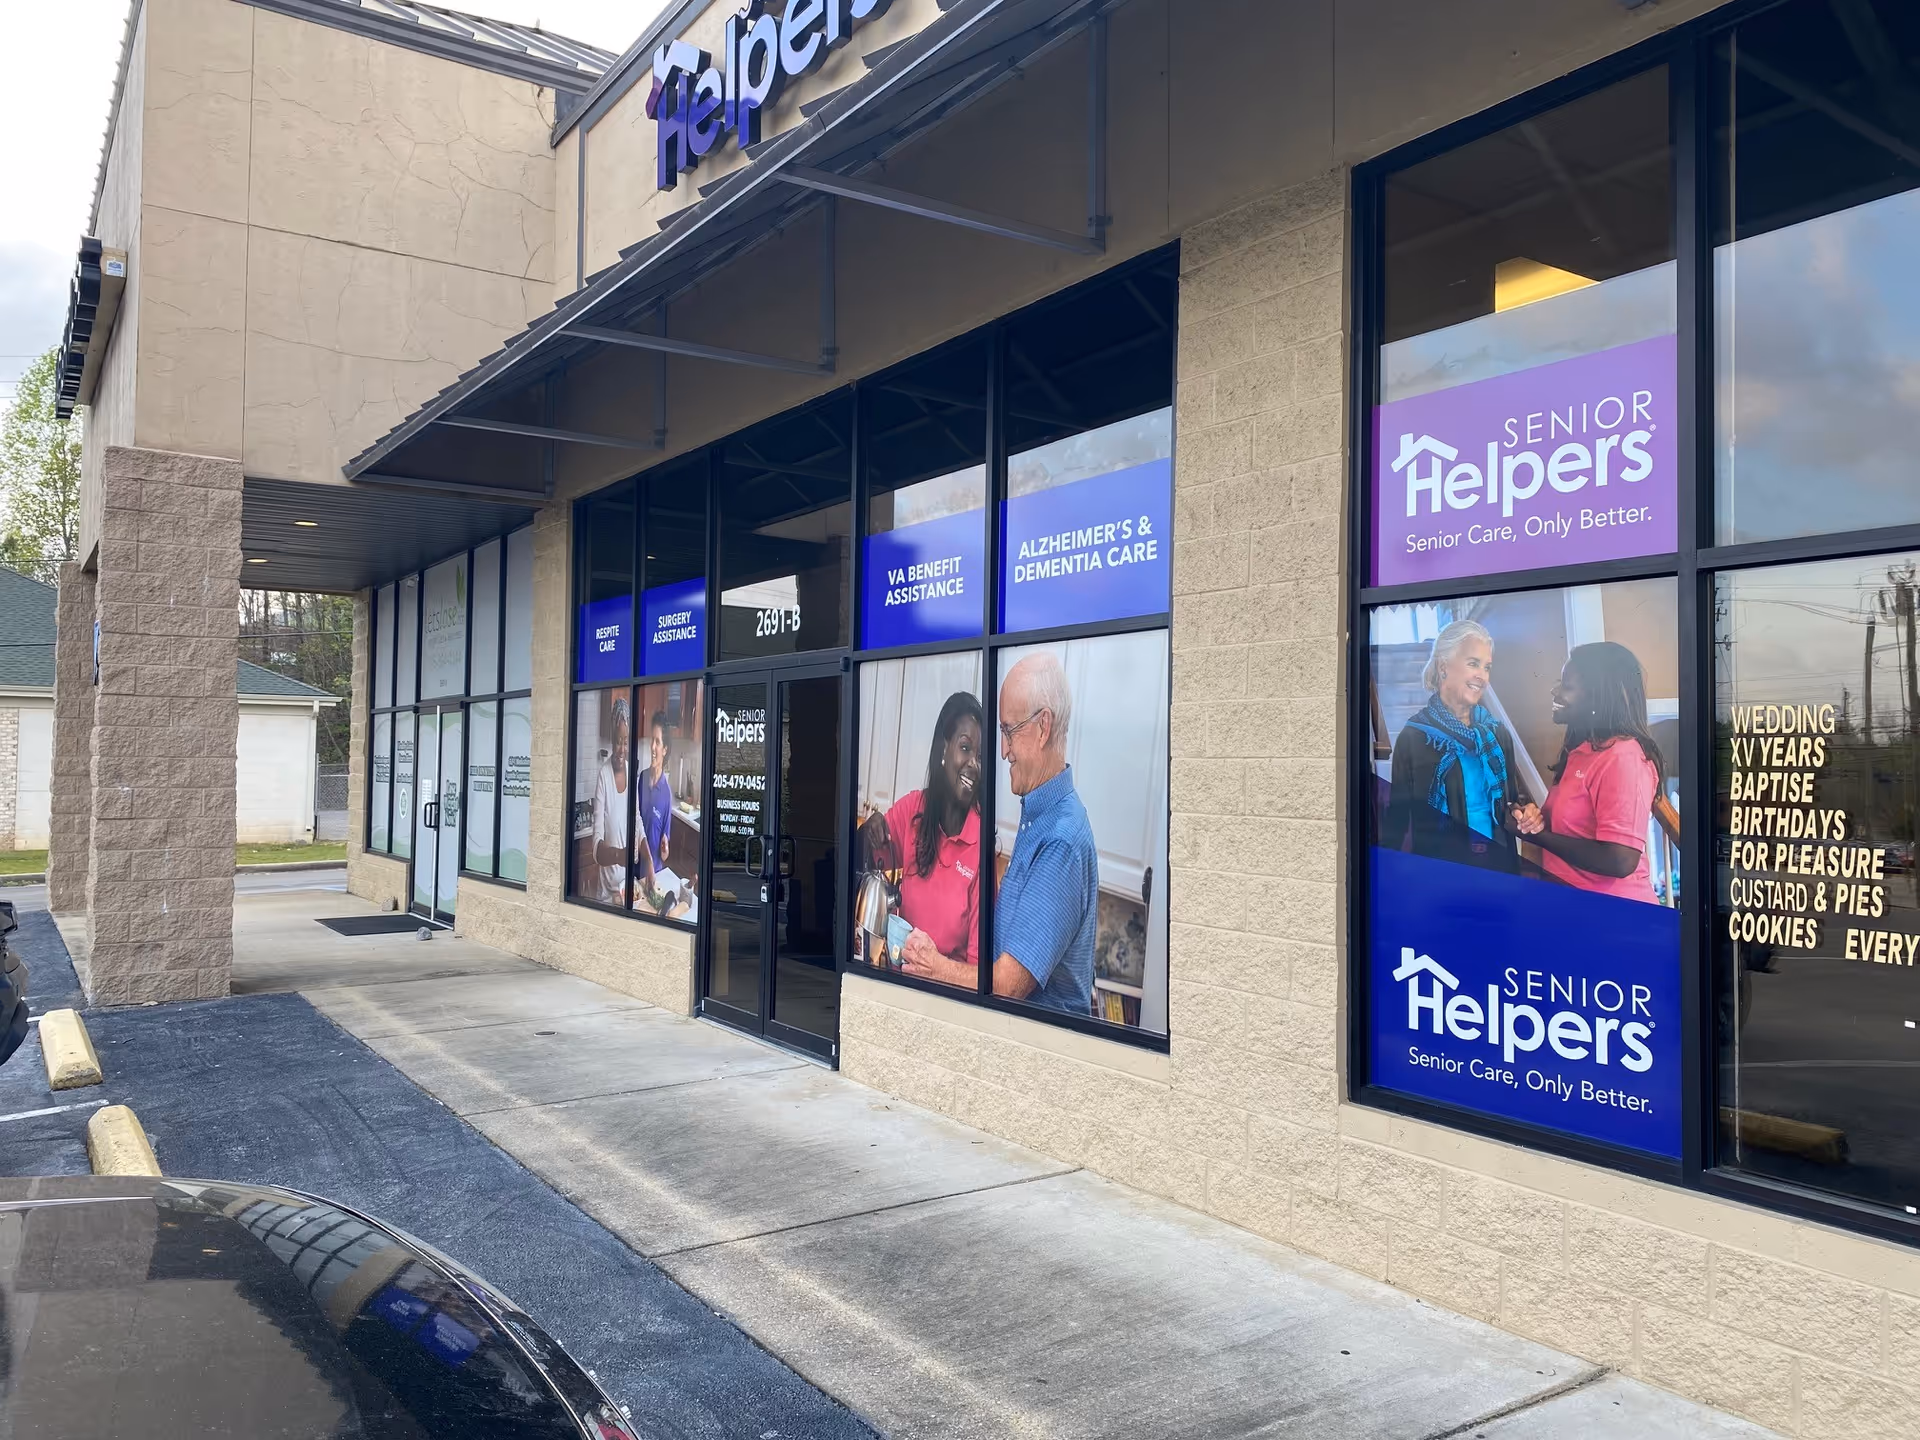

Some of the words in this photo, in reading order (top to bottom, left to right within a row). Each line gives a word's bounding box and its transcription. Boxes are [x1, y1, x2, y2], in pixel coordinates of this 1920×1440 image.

[645, 0, 884, 191] Helper
[1503, 390, 1653, 448] SENIOR
[1391, 430, 1654, 518] Helpers
[1018, 519, 1132, 560] ALZHEIMER'S
[1137, 515, 1152, 536] &
[1406, 531, 1462, 553] Senior
[1468, 524, 1517, 544] Care,
[1524, 512, 1573, 539] Only
[1580, 506, 1653, 530] Better.
[887, 567, 906, 586] VA
[907, 556, 962, 582] BENEFIT
[1014, 551, 1103, 584] DEMENTIA
[1106, 540, 1158, 567] CARE
[884, 577, 964, 607] ASSISTANCE
[595, 624, 620, 640] RESPITE
[652, 625, 697, 644] ASSISTANCE
[658, 611, 692, 629] SURGERY
[755, 604, 801, 637] 2691-B
[599, 640, 616, 653] CARE
[737, 709, 766, 722] SENIOR
[1731, 703, 1836, 734] WEDDING
[717, 717, 766, 749] Helpers
[1730, 737, 1755, 767] XV
[1760, 736, 1827, 768] YEARS
[713, 774, 766, 790] 205-479-0452
[1730, 771, 1815, 803] BAPTISE
[717, 799, 741, 810] BUSINESS
[741, 801, 760, 812] HOURS
[740, 815, 756, 825] FRIDAY
[1730, 806, 1847, 841] BIRTHDAYS
[1730, 840, 1769, 872] FOR
[1774, 843, 1886, 880] PLEASURE
[1730, 877, 1808, 912] CUSTARD
[1813, 881, 1828, 912] &
[1834, 883, 1885, 918] PIES
[1728, 911, 1818, 949] COOKIES
[1844, 928, 1920, 967] EVERY
[1503, 967, 1653, 1017] SENIOR
[1393, 974, 1654, 1073] Helpers
[1408, 1046, 1464, 1074] Senior
[1469, 1059, 1519, 1089] Care,
[1525, 1069, 1574, 1102] Only
[1581, 1080, 1653, 1114] Better.
